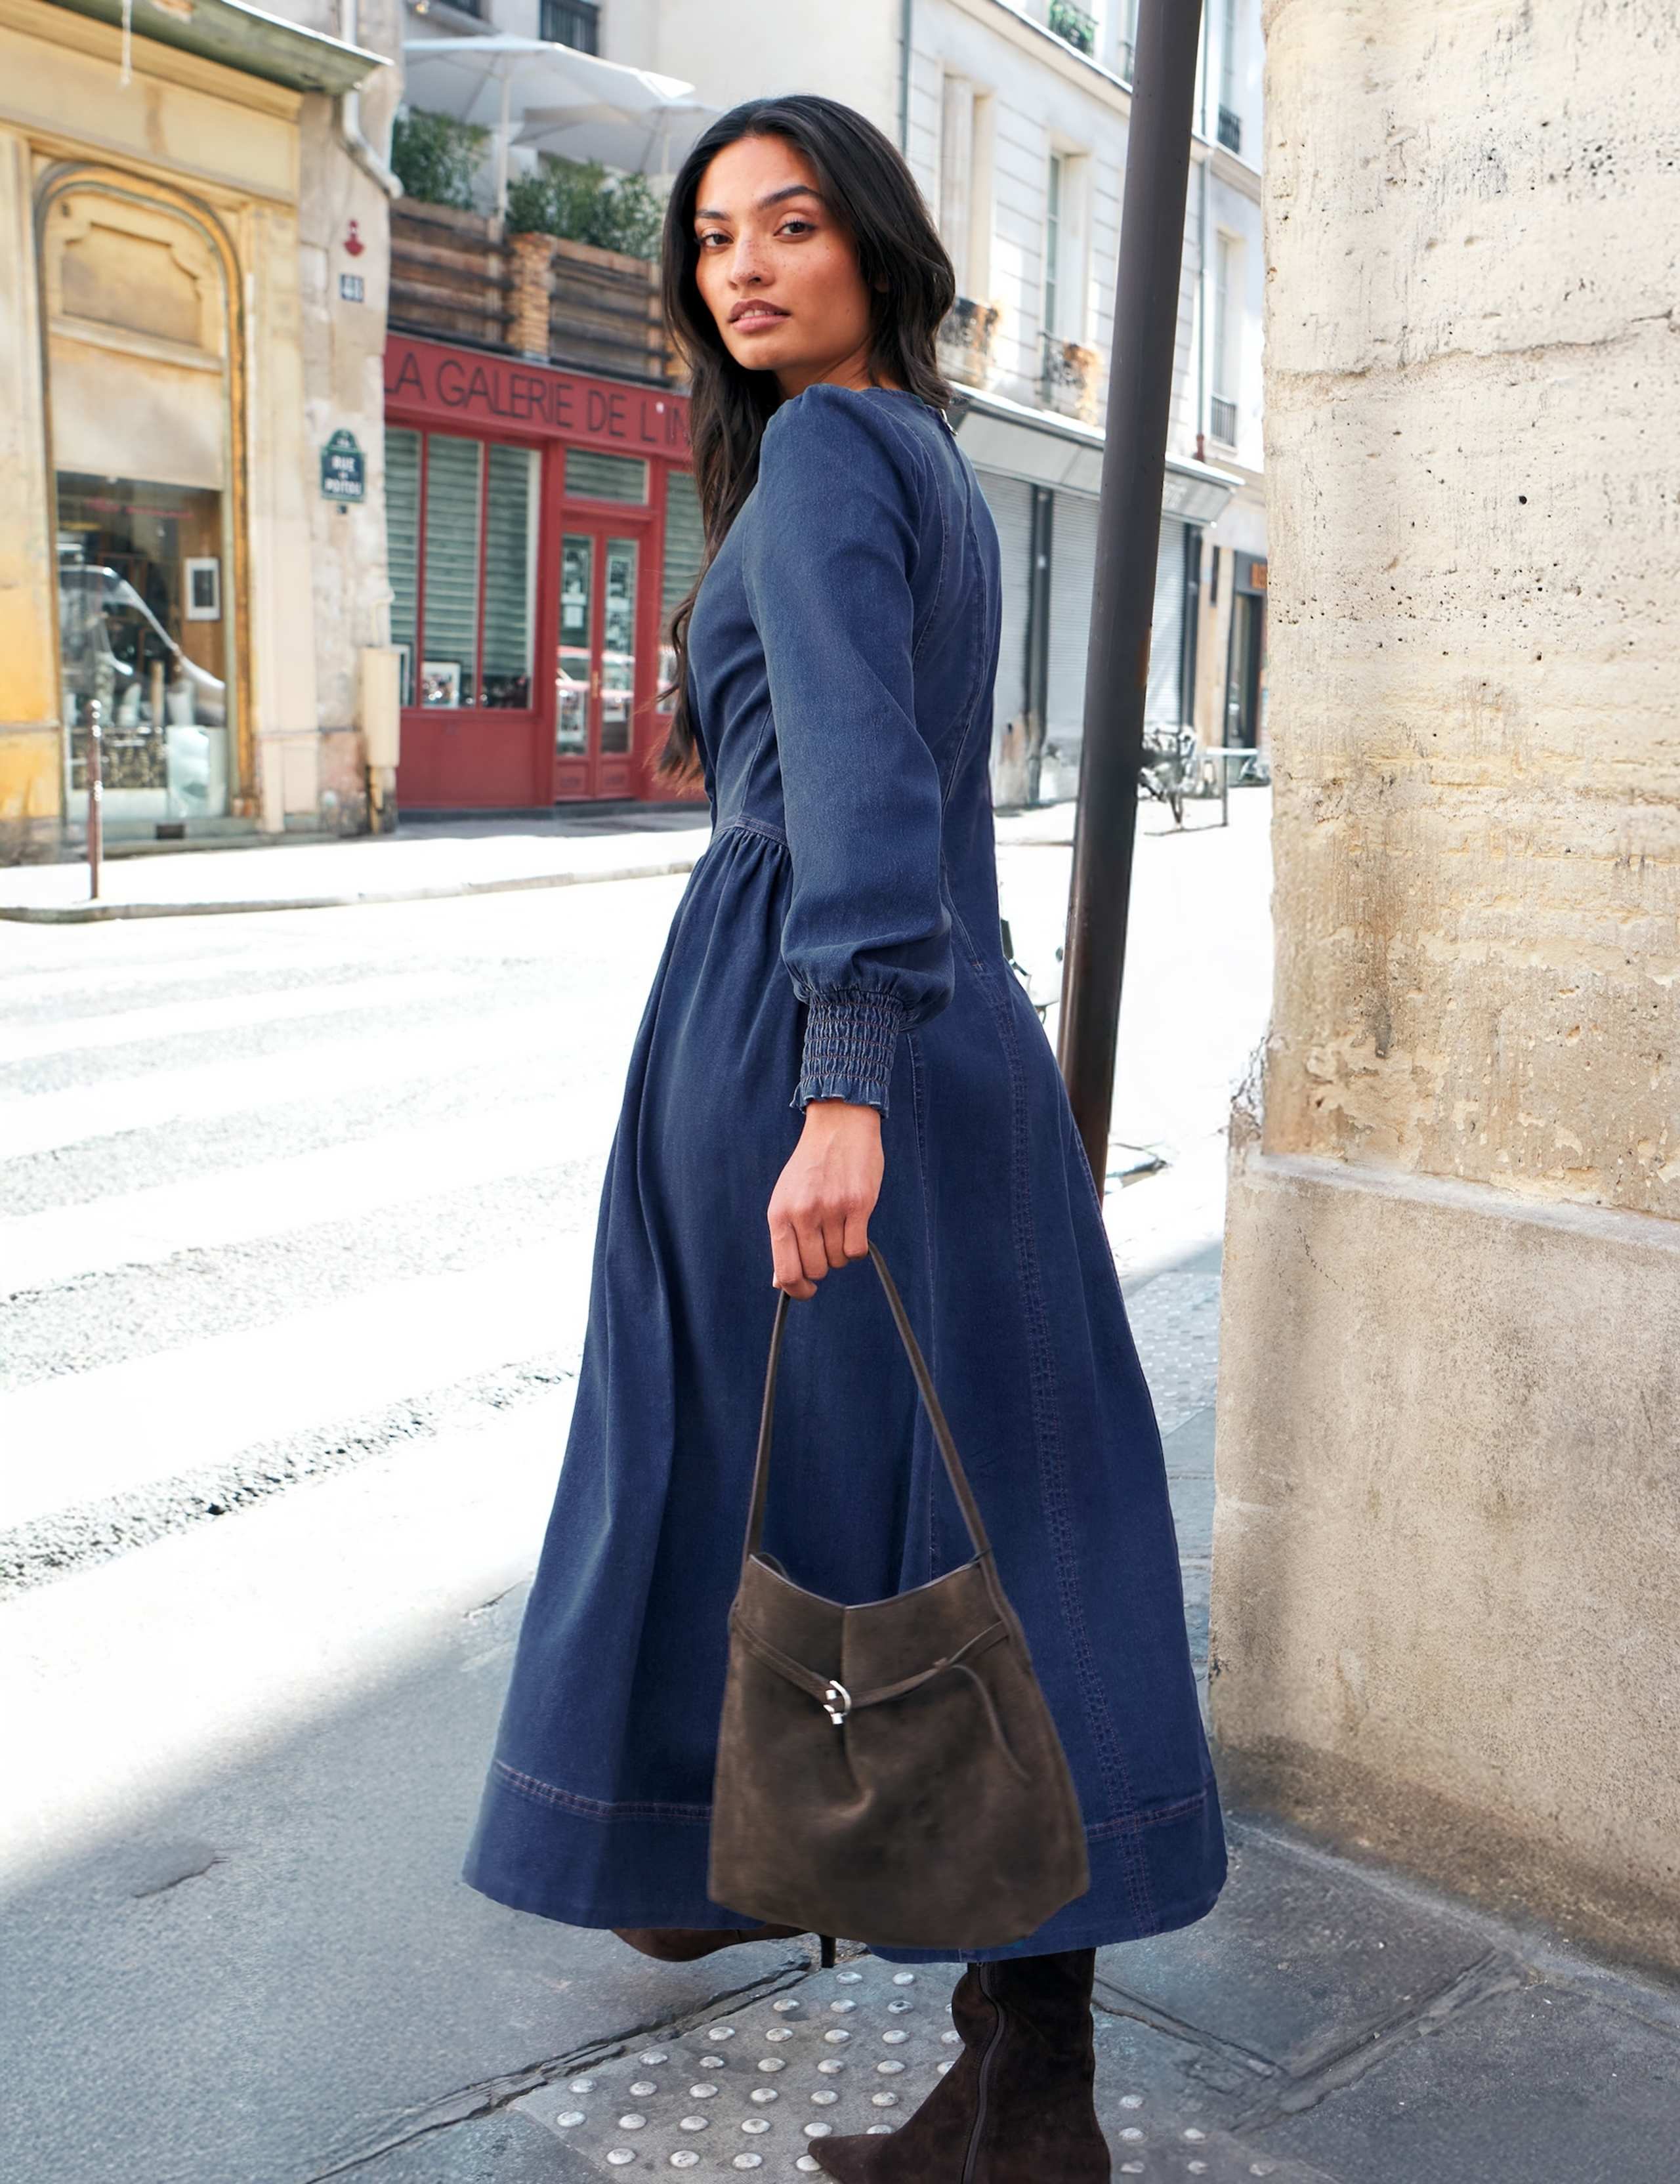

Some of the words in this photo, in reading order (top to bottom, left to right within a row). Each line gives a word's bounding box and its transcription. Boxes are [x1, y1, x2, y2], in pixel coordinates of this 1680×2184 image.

[436, 358, 573, 429] GALERIE
[587, 388, 626, 438] DE
[331, 455, 355, 472] RUE
